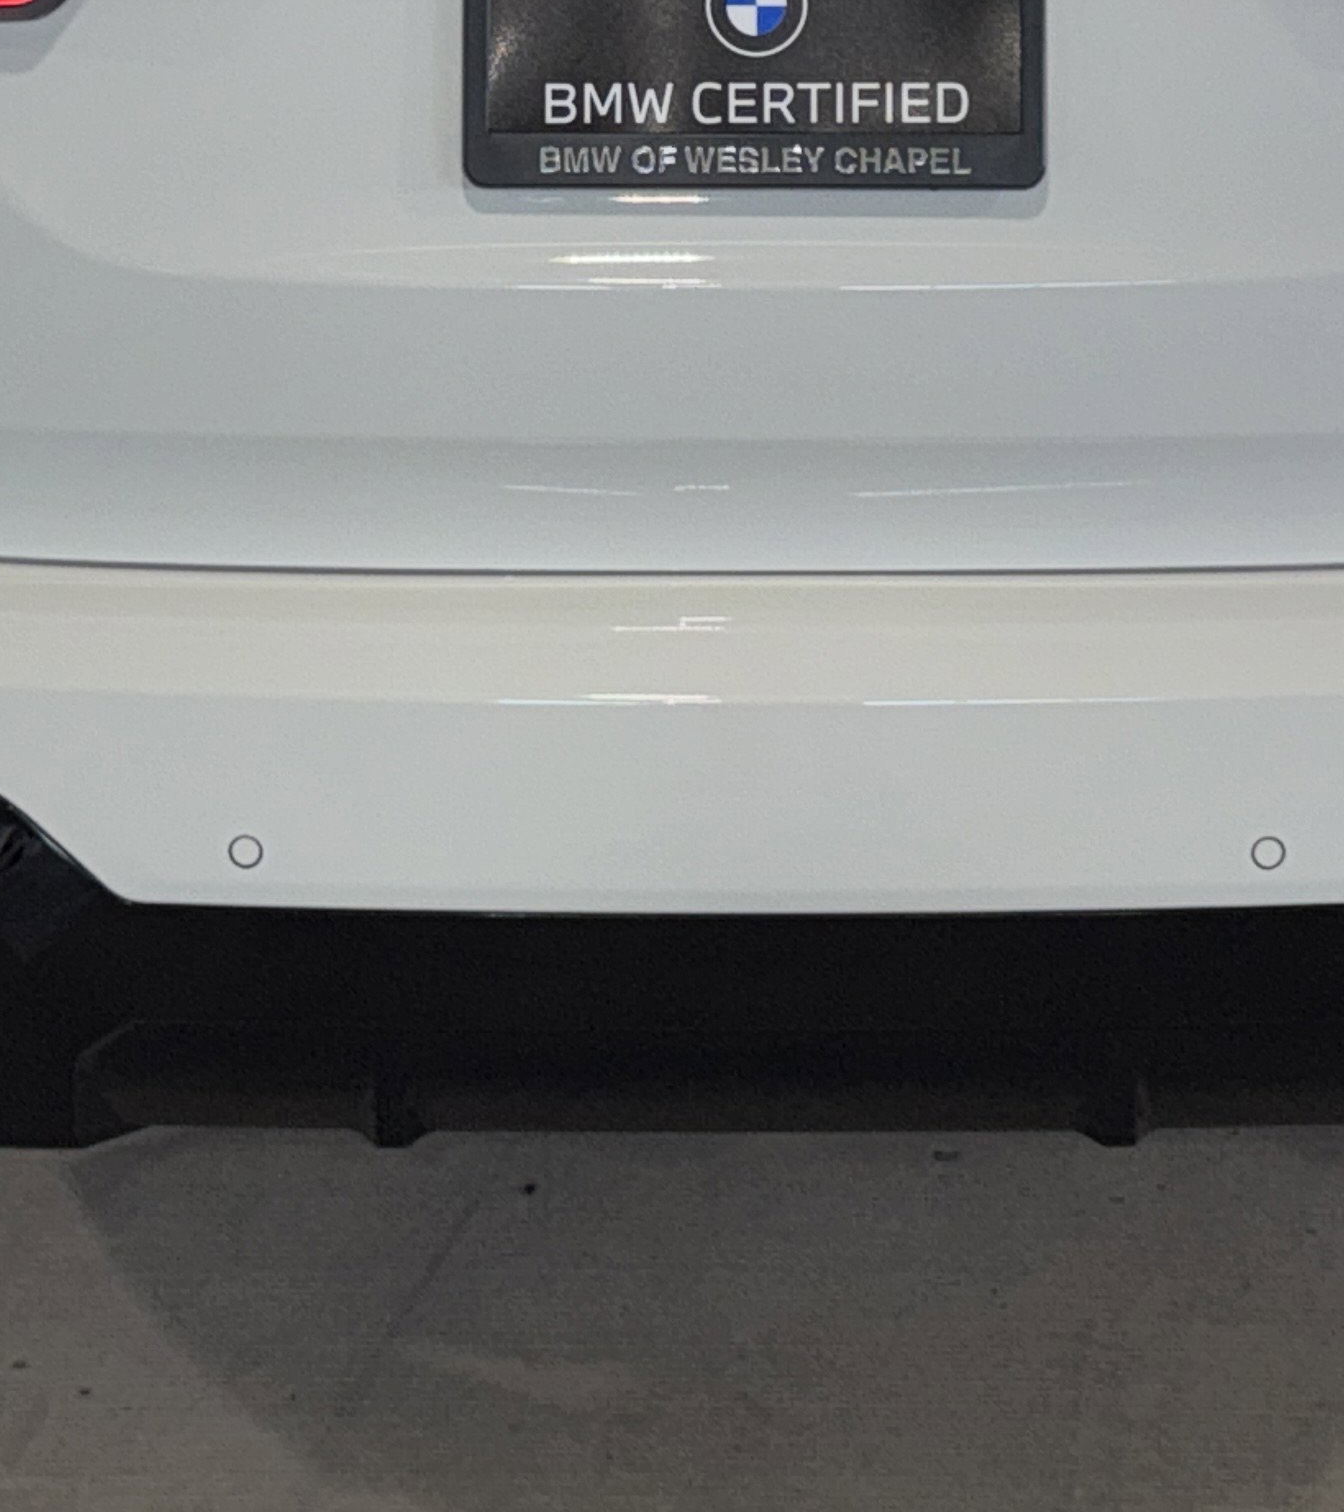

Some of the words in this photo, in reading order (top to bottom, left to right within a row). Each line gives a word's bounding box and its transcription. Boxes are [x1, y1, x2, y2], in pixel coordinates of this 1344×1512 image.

[544, 82, 674, 124] BMW
[692, 82, 970, 125] CERTIFIED
[539, 146, 622, 173] BMW
[631, 145, 678, 174] OF
[684, 144, 825, 174] WESLEY
[834, 146, 972, 175] CHAPEL
